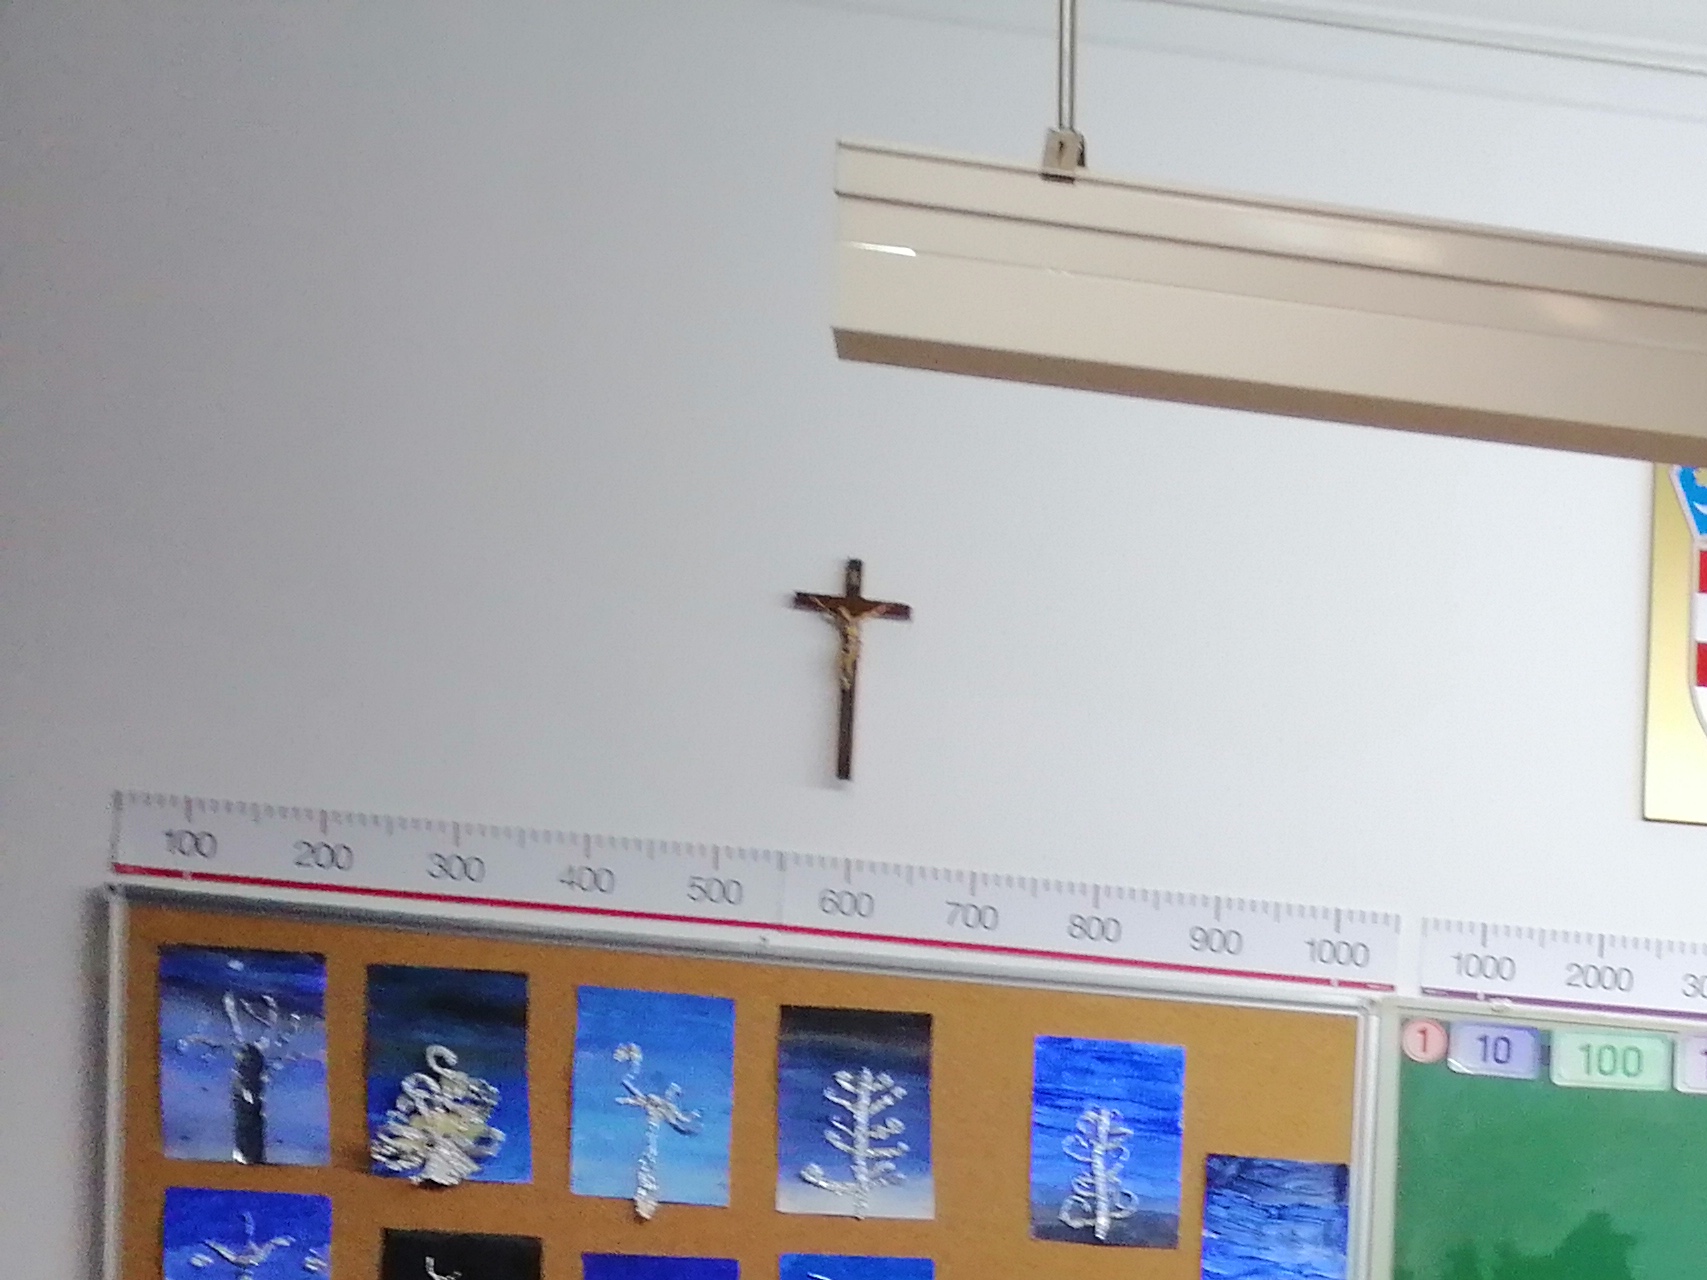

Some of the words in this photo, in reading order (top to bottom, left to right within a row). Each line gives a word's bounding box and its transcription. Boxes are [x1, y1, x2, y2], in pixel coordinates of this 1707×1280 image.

[162, 827, 218, 860] 100
[293, 840, 354, 872] 200
[427, 852, 486, 883] 300
[559, 864, 615, 895] 400
[687, 875, 743, 906] 500
[817, 888, 874, 919] 600
[946, 901, 1000, 932] 700
[1067, 913, 1122, 944] 800
[1189, 926, 1244, 956] 900
[1305, 937, 1370, 970] 1000
[1452, 952, 1516, 982] 1000
[1565, 962, 1634, 993] 2000
[1414, 1028, 1431, 1053] 1
[1475, 1034, 1512, 1064] 10
[1577, 1042, 1644, 1078] 100
